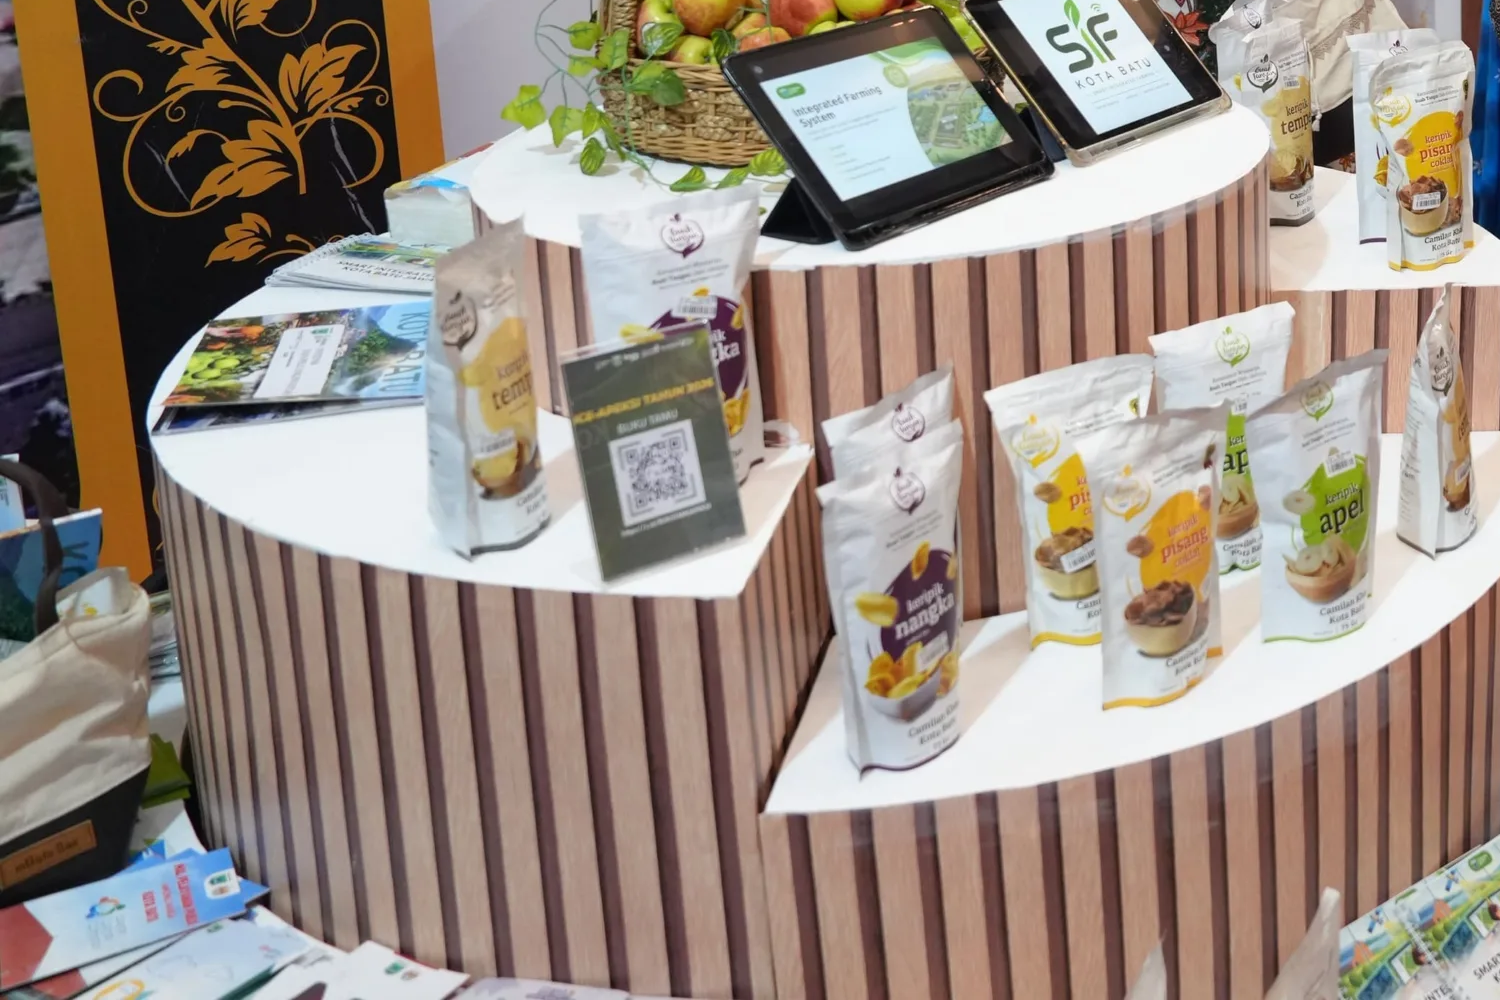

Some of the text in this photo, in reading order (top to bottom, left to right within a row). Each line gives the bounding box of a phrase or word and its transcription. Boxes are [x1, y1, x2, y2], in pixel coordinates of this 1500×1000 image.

[1075, 70, 1114, 90] KOTA
[1118, 58, 1152, 76] BATU
[792, 85, 883, 118] Integrated Farming
[799, 111, 837, 129] System
[1425, 132, 1452, 144] keripik
[338, 260, 374, 269] SMART
[396, 312, 430, 343] KOTA
[617, 409, 678, 435] BUKU TAMU
[1325, 483, 1359, 506] keripik
[1319, 489, 1365, 534] apel
[1168, 513, 1199, 537] keripik
[1161, 525, 1209, 564] pisang
[906, 582, 945, 613] keripik
[1319, 596, 1355, 617] Camilan
[895, 592, 955, 640] nangka
[1328, 612, 1349, 625] Kota
